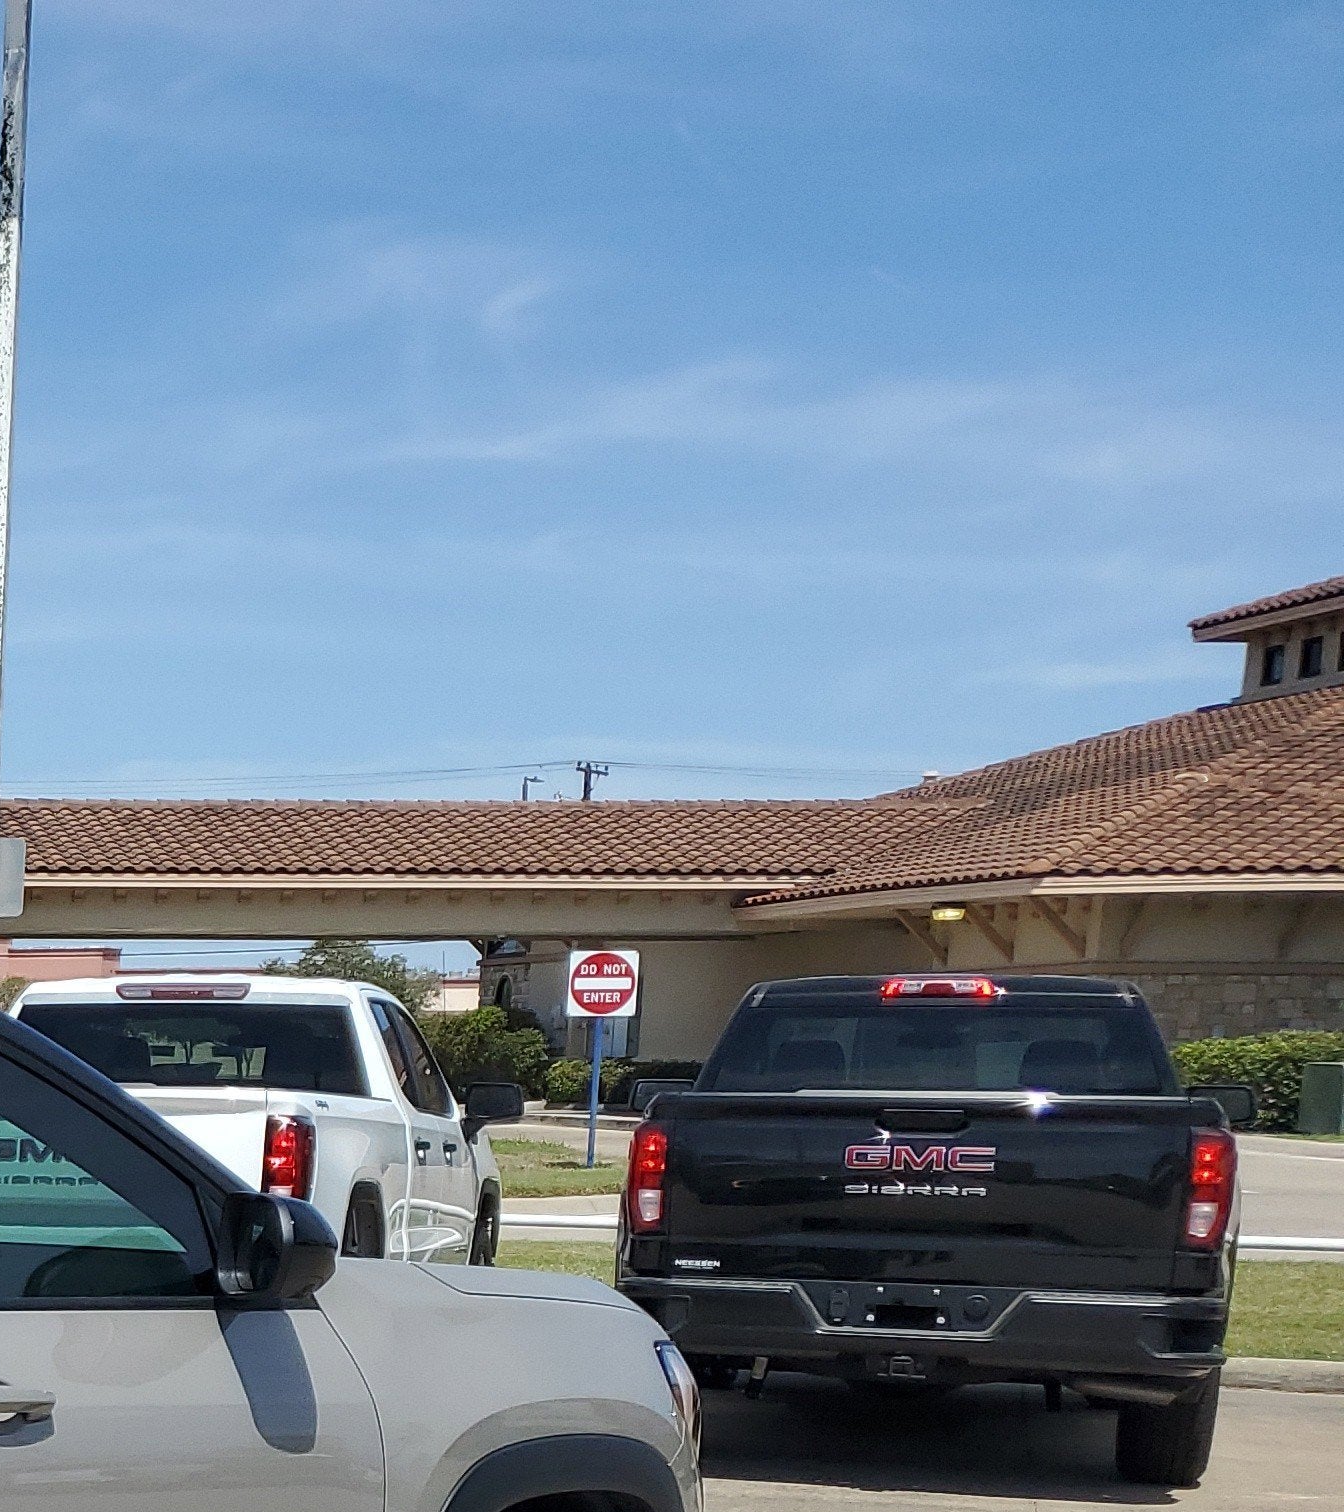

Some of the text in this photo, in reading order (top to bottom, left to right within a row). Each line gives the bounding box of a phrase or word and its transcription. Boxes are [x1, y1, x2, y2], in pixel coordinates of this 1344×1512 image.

[580, 963, 628, 975] DO NOT
[583, 992, 621, 1003] ENTER
[844, 1145, 996, 1172] GMC
[844, 1182, 987, 1197] SIERRA
